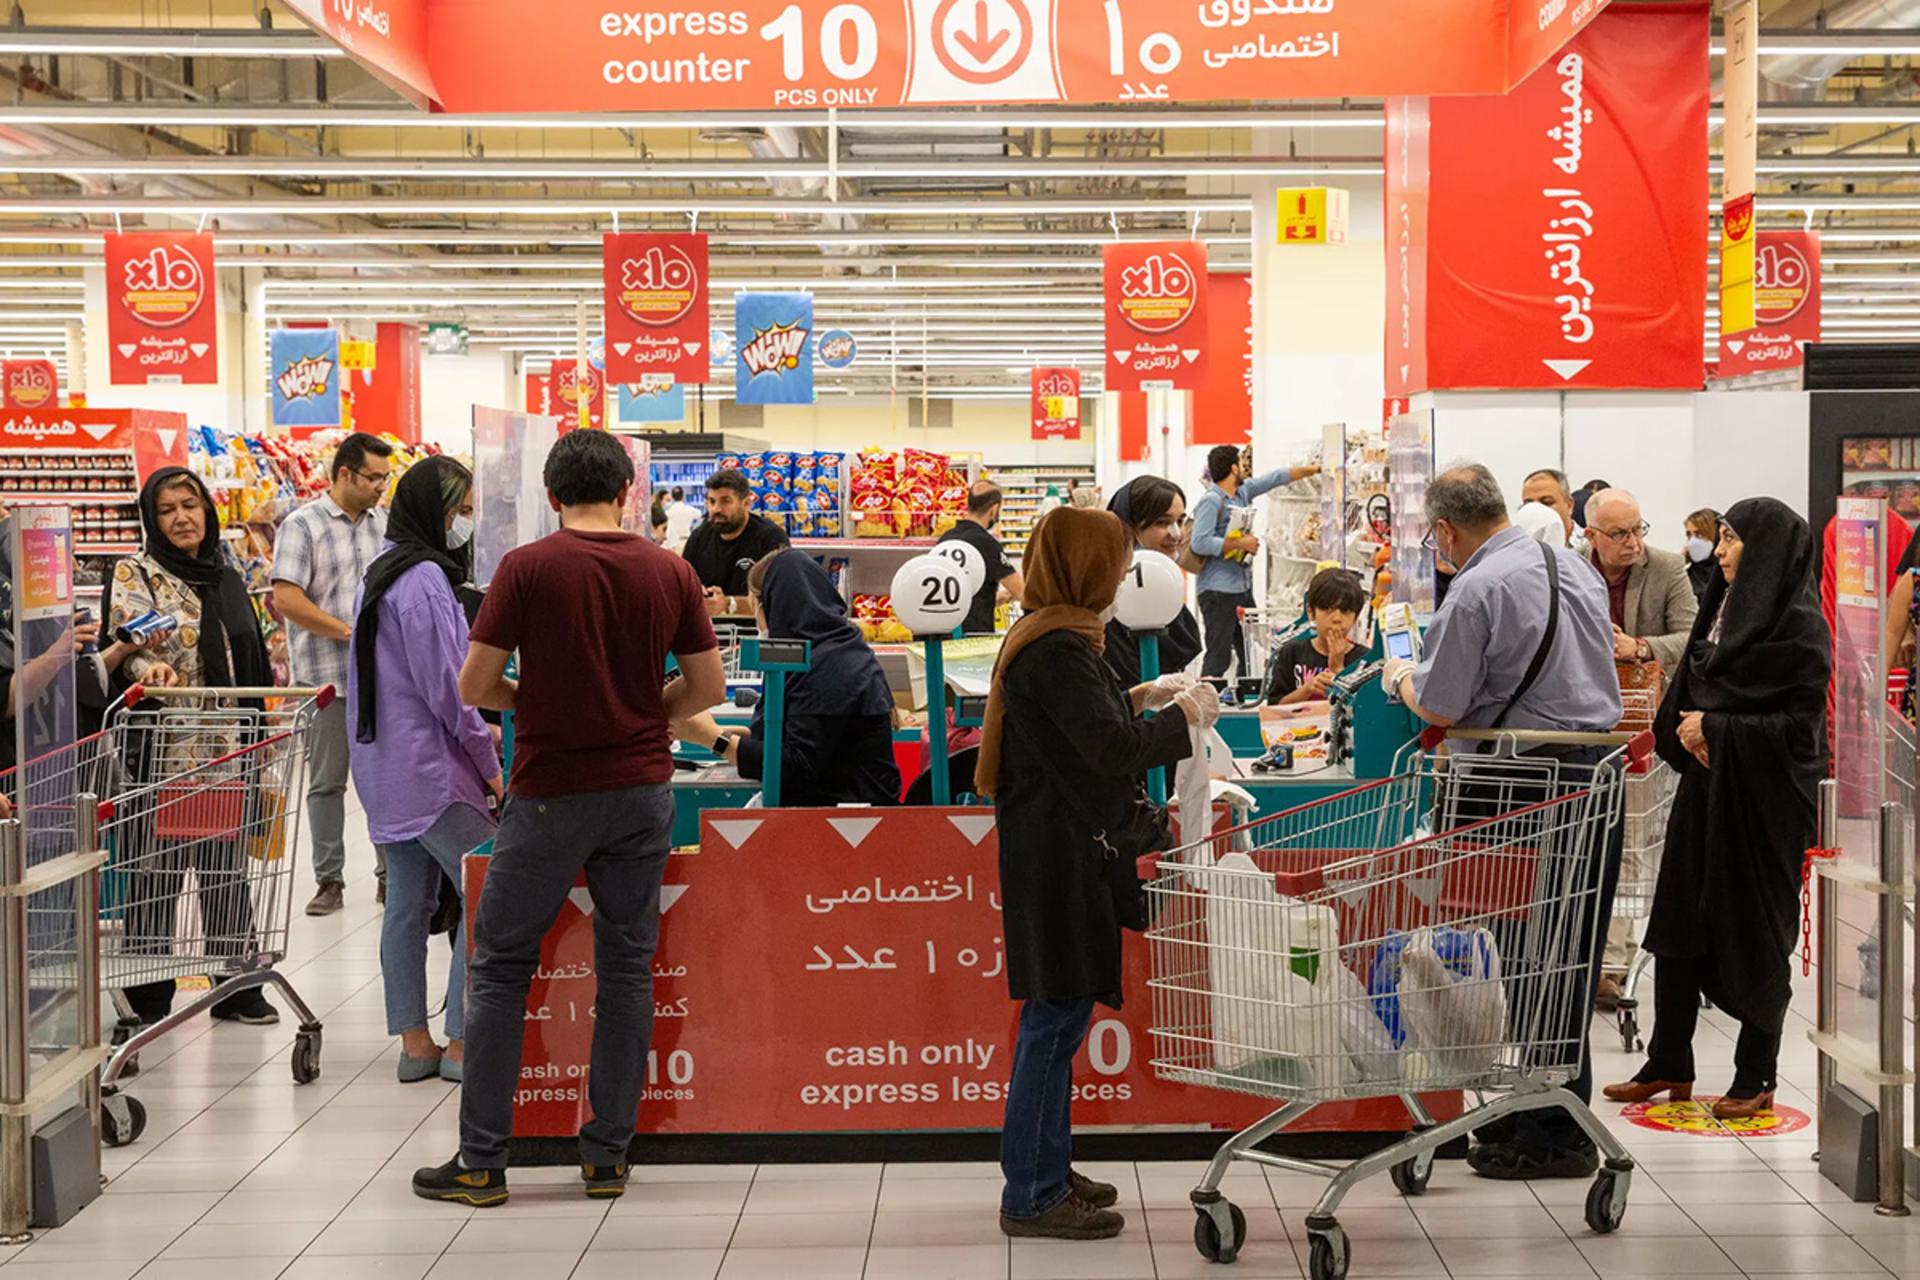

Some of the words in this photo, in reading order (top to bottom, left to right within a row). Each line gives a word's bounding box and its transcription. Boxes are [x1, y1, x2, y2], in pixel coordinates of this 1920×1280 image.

[599, 11, 750, 44] express
[760, 3, 879, 81] 10
[1203, 32, 1339, 68] اختصاصی
[602, 52, 751, 83] counter
[774, 89, 817, 105] PCS
[822, 88, 878, 104] ONLY
[1119, 82, 1169, 100] عدد
[1546, 53, 1592, 174] همیشه
[3, 415, 77, 441] همیشه
[921, 576, 961, 607] 20
[805, 874, 974, 914] اختصاصی
[805, 944, 897, 972] عدد
[825, 1039, 908, 1067] cash
[920, 1038, 996, 1070] only
[1087, 1018, 1134, 1076] 0
[520, 1062, 560, 1079] ash
[647, 1049, 694, 1085] 10
[799, 1083, 940, 1110] express
